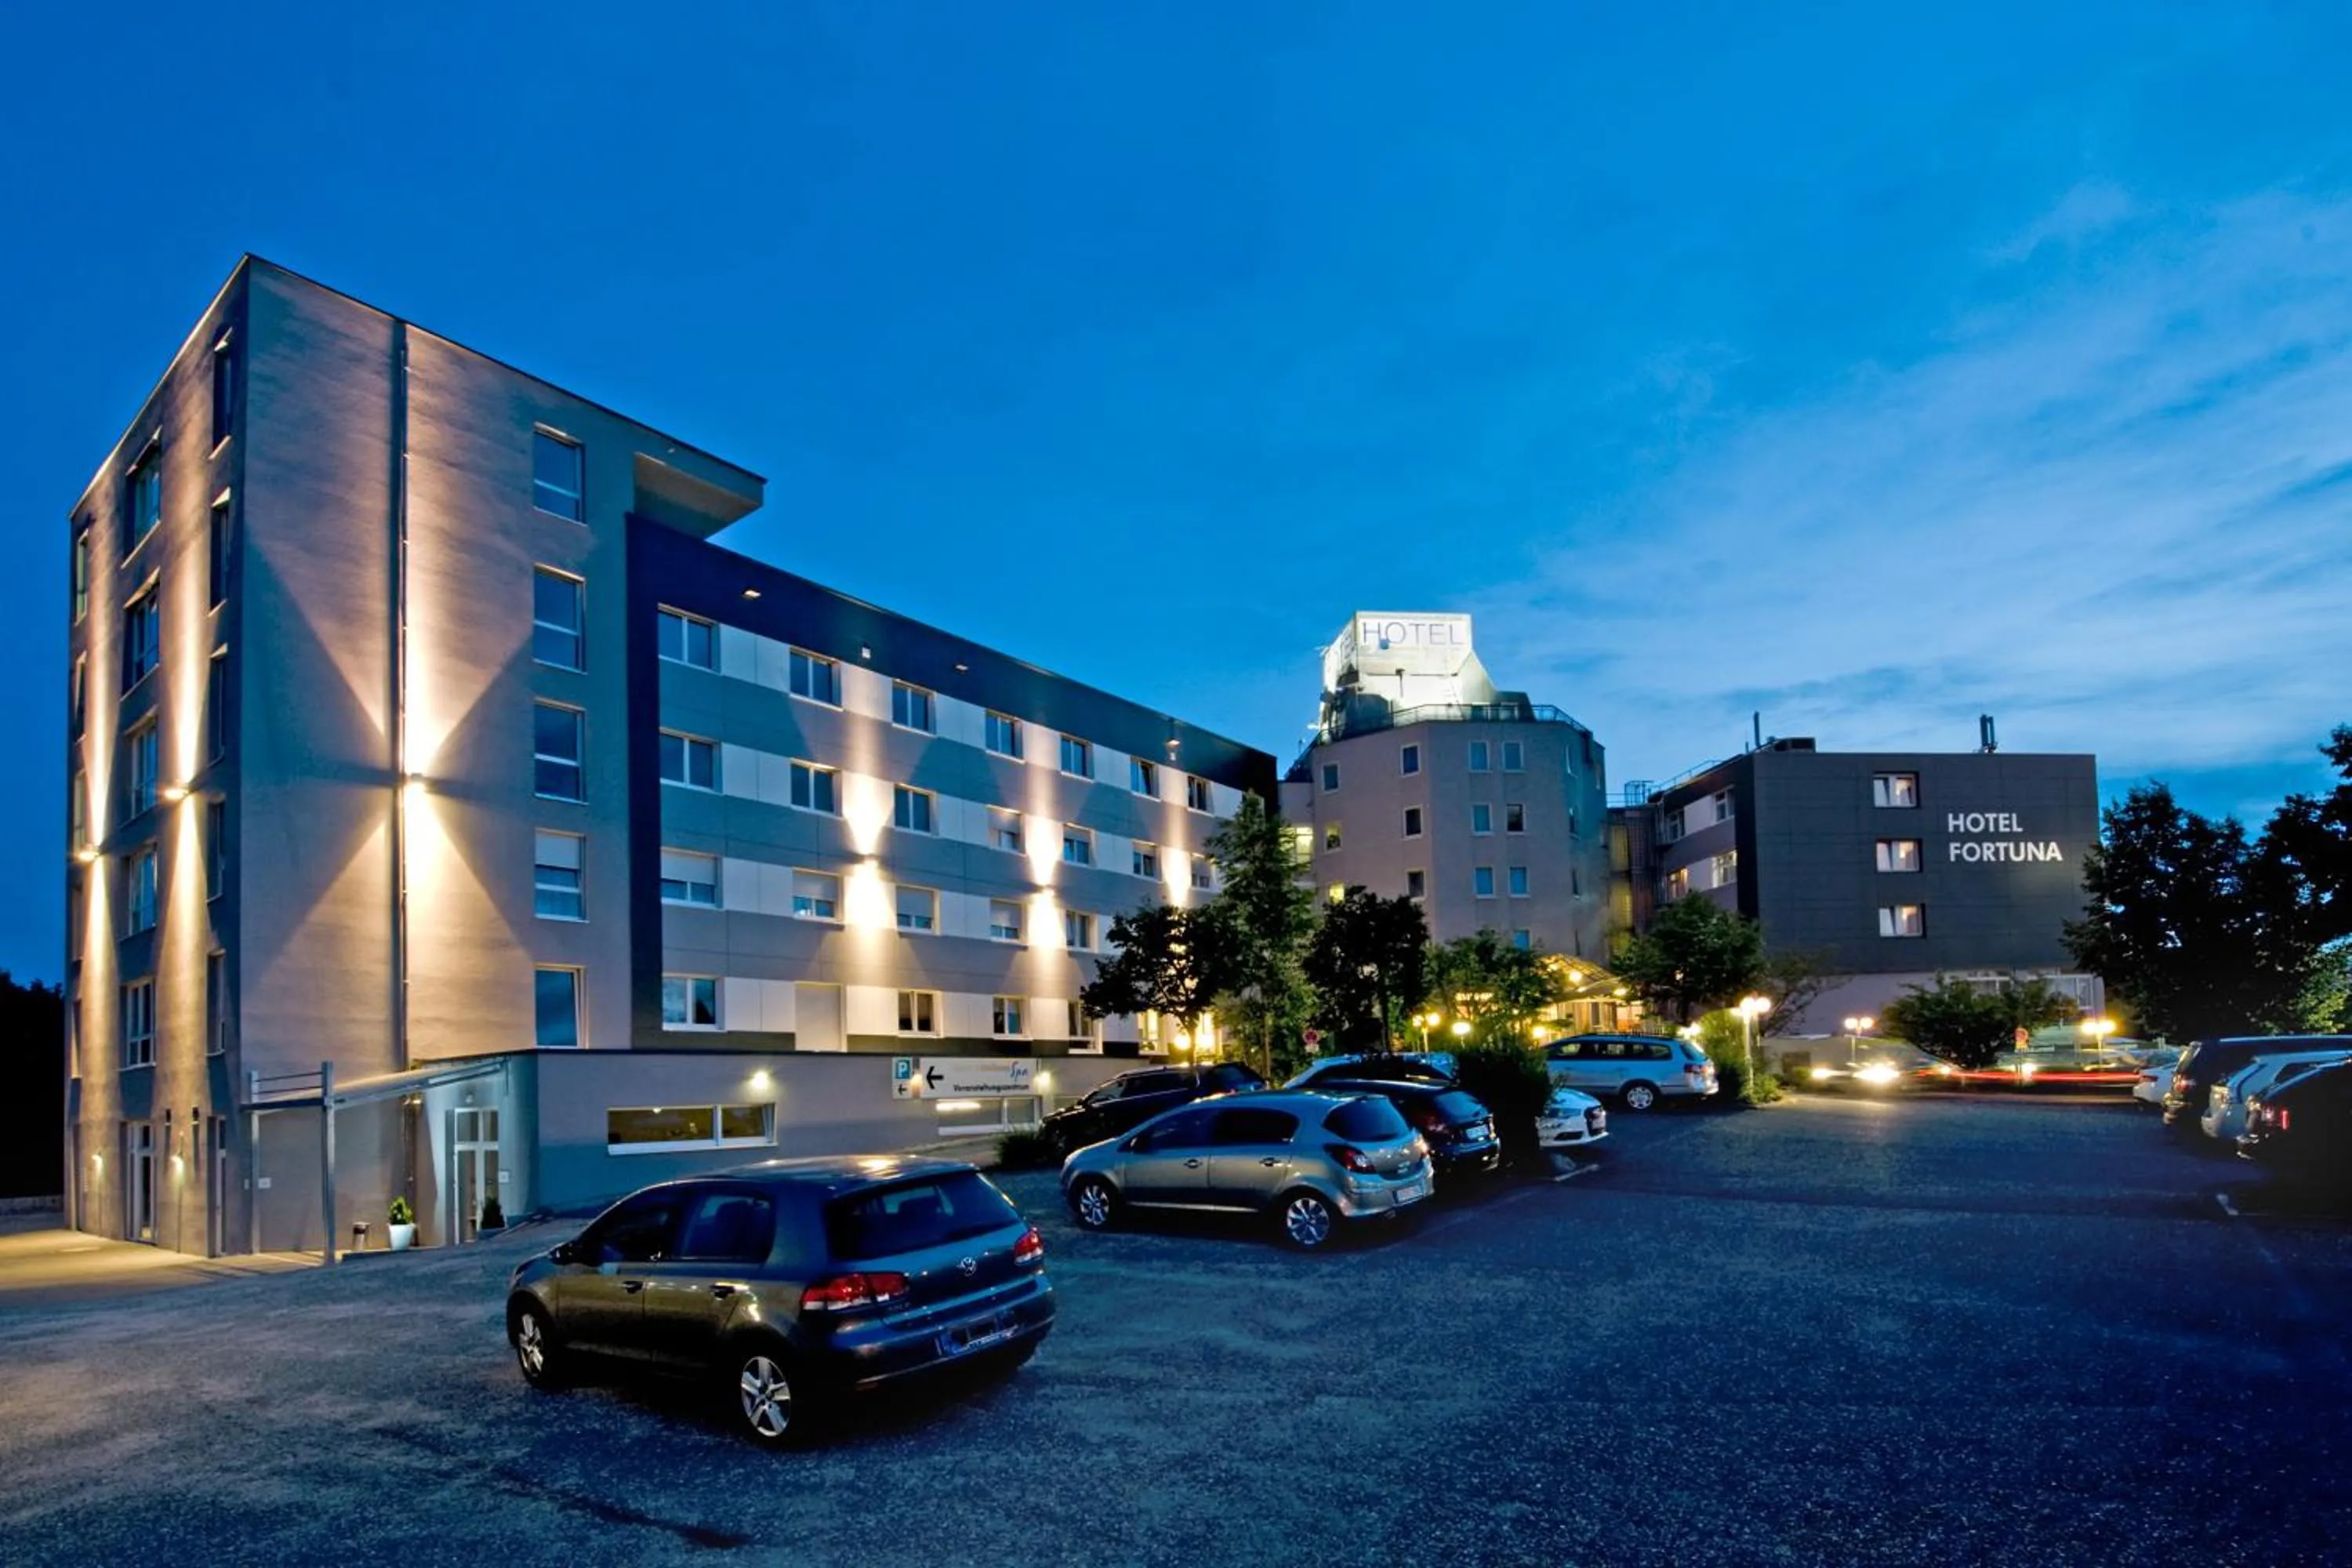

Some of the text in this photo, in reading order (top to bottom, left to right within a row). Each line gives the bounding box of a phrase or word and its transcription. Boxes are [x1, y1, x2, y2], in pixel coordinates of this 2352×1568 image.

[1363, 622, 1464, 644] HOTEL
[1947, 813, 2023, 833] HOTEL
[1950, 841, 2063, 862] FORTUNA
[898, 1062, 908, 1078] P
